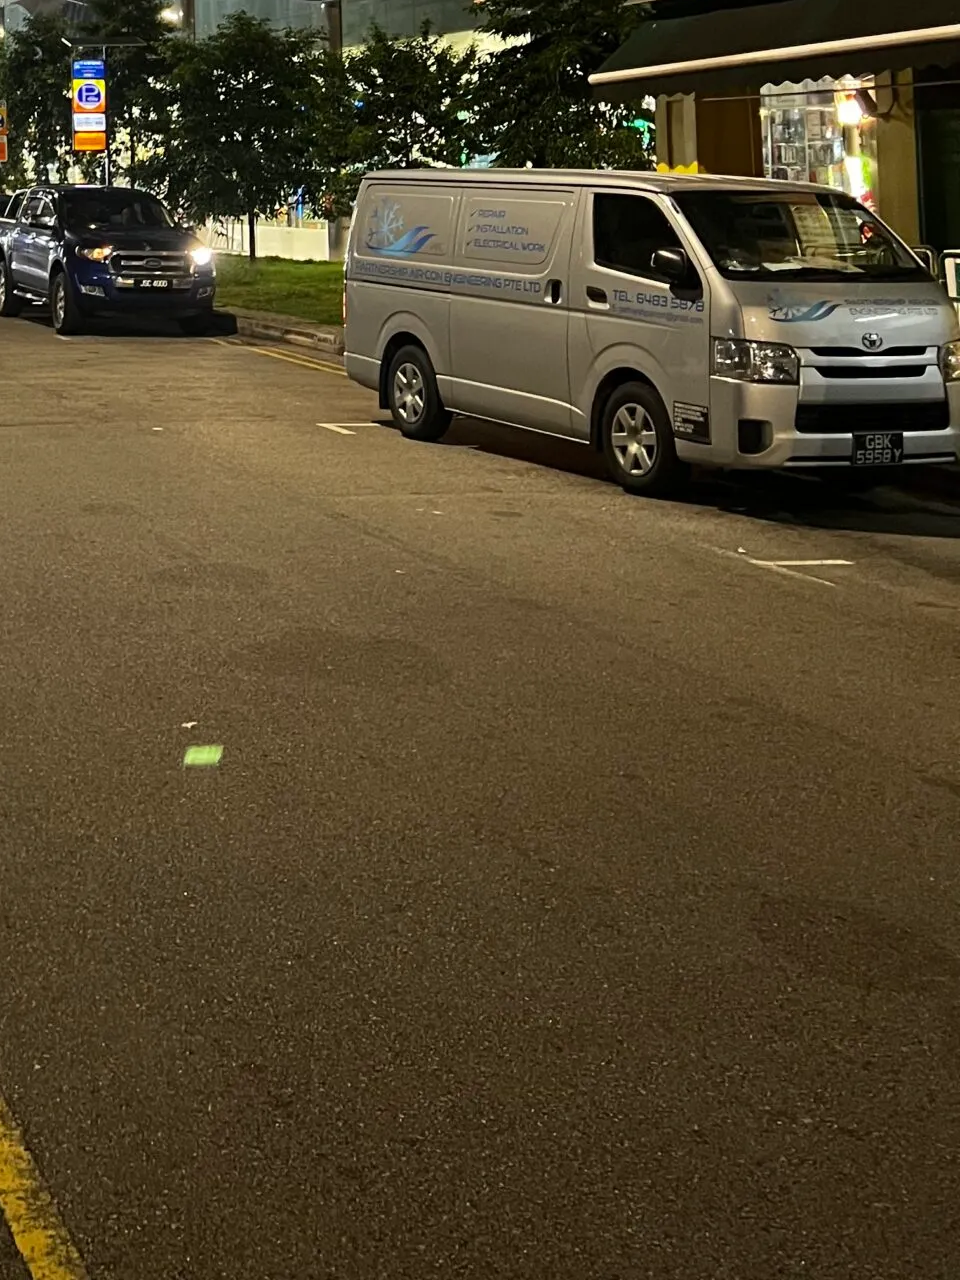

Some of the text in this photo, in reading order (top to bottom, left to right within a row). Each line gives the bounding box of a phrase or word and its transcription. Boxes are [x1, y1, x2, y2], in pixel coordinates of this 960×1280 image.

[478, 209, 506, 218] REPAIR
[476, 224, 529, 235] INSTALLATION
[474, 238, 545, 252] ELECTRICAL WORK
[445, 272, 502, 289] ENGINEERING
[504, 279, 522, 291] PTE
[524, 281, 541, 293] LTD
[636, 292, 668, 307] 6483
[865, 434, 893, 449] GBK
